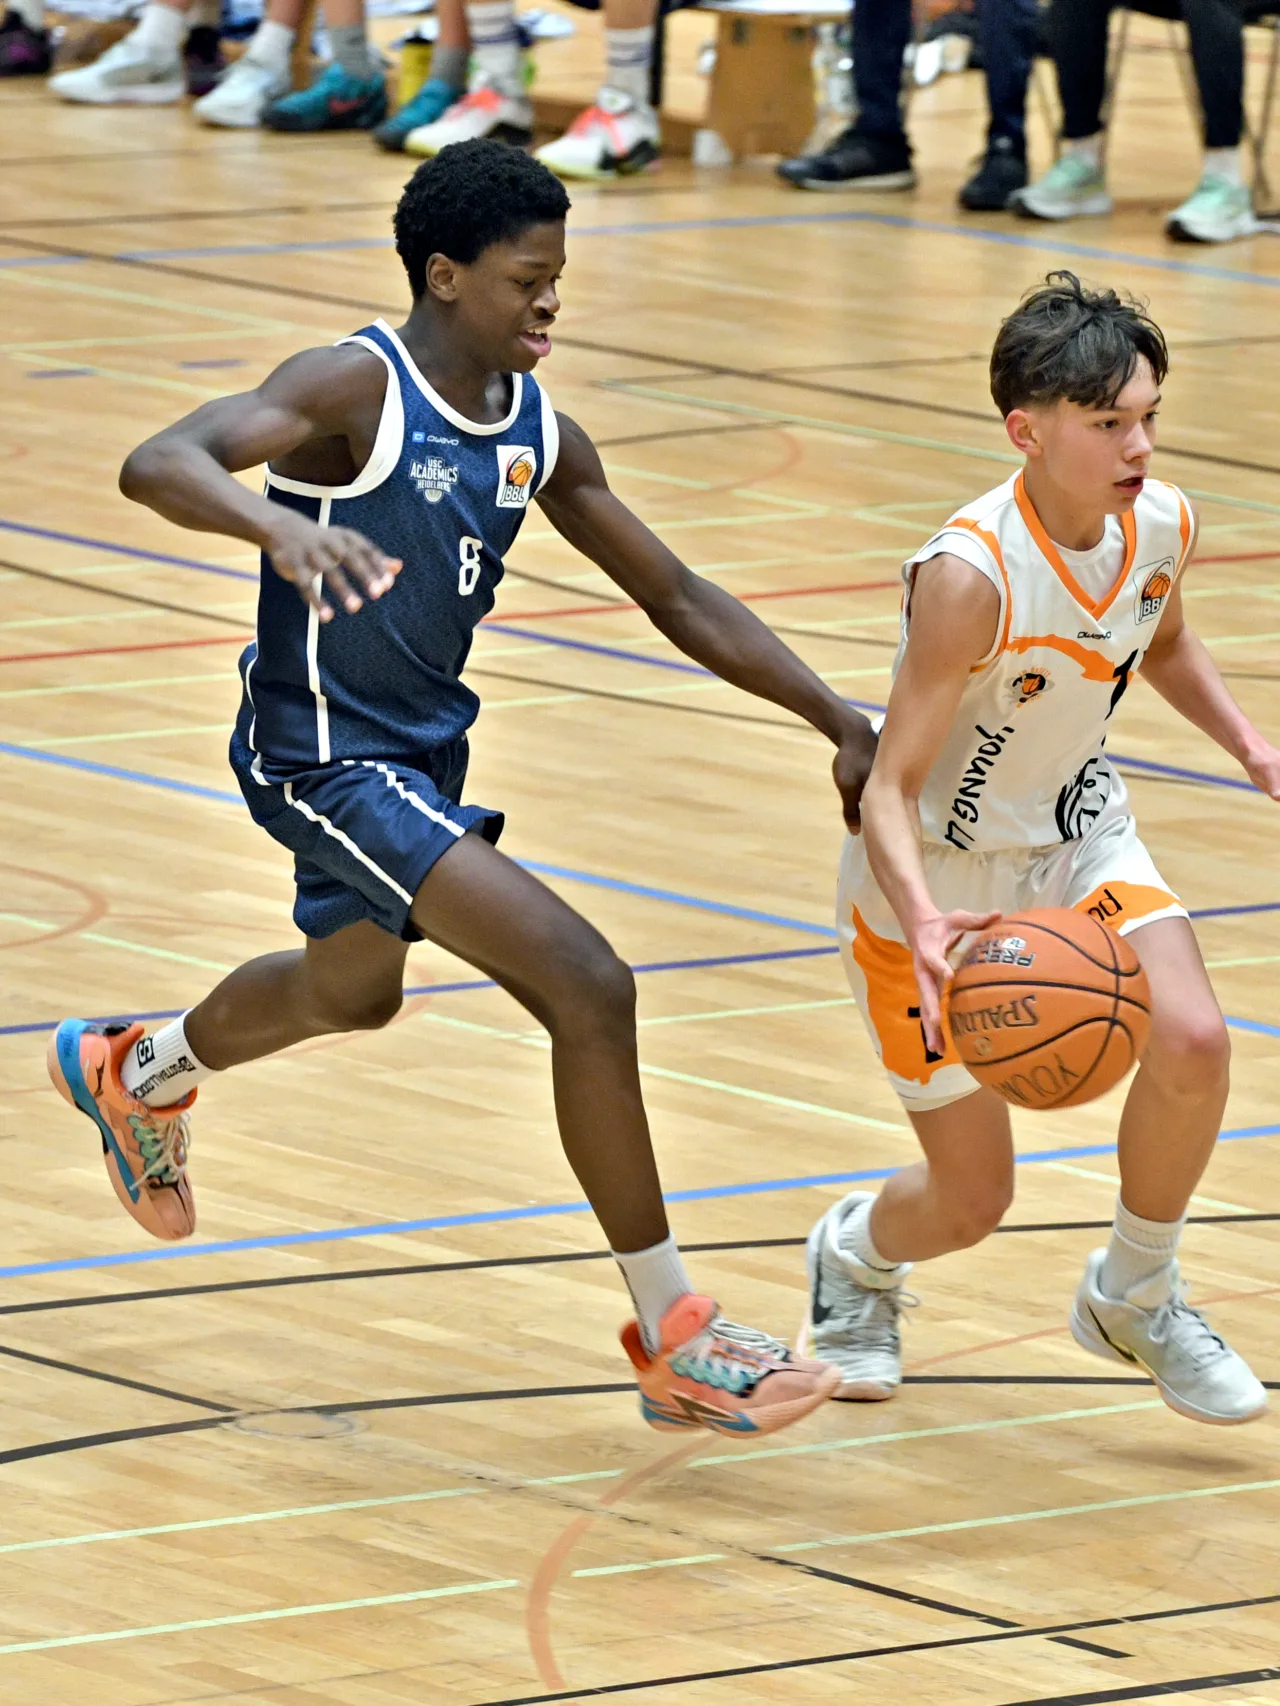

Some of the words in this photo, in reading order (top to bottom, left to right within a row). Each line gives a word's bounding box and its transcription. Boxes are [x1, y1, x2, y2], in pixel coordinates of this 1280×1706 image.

[410, 461, 458, 482] ACADEMICS
[427, 458, 443, 468] USC
[500, 484, 525, 505] JBBL
[458, 536, 483, 596] 8
[1138, 594, 1165, 621] JBB
